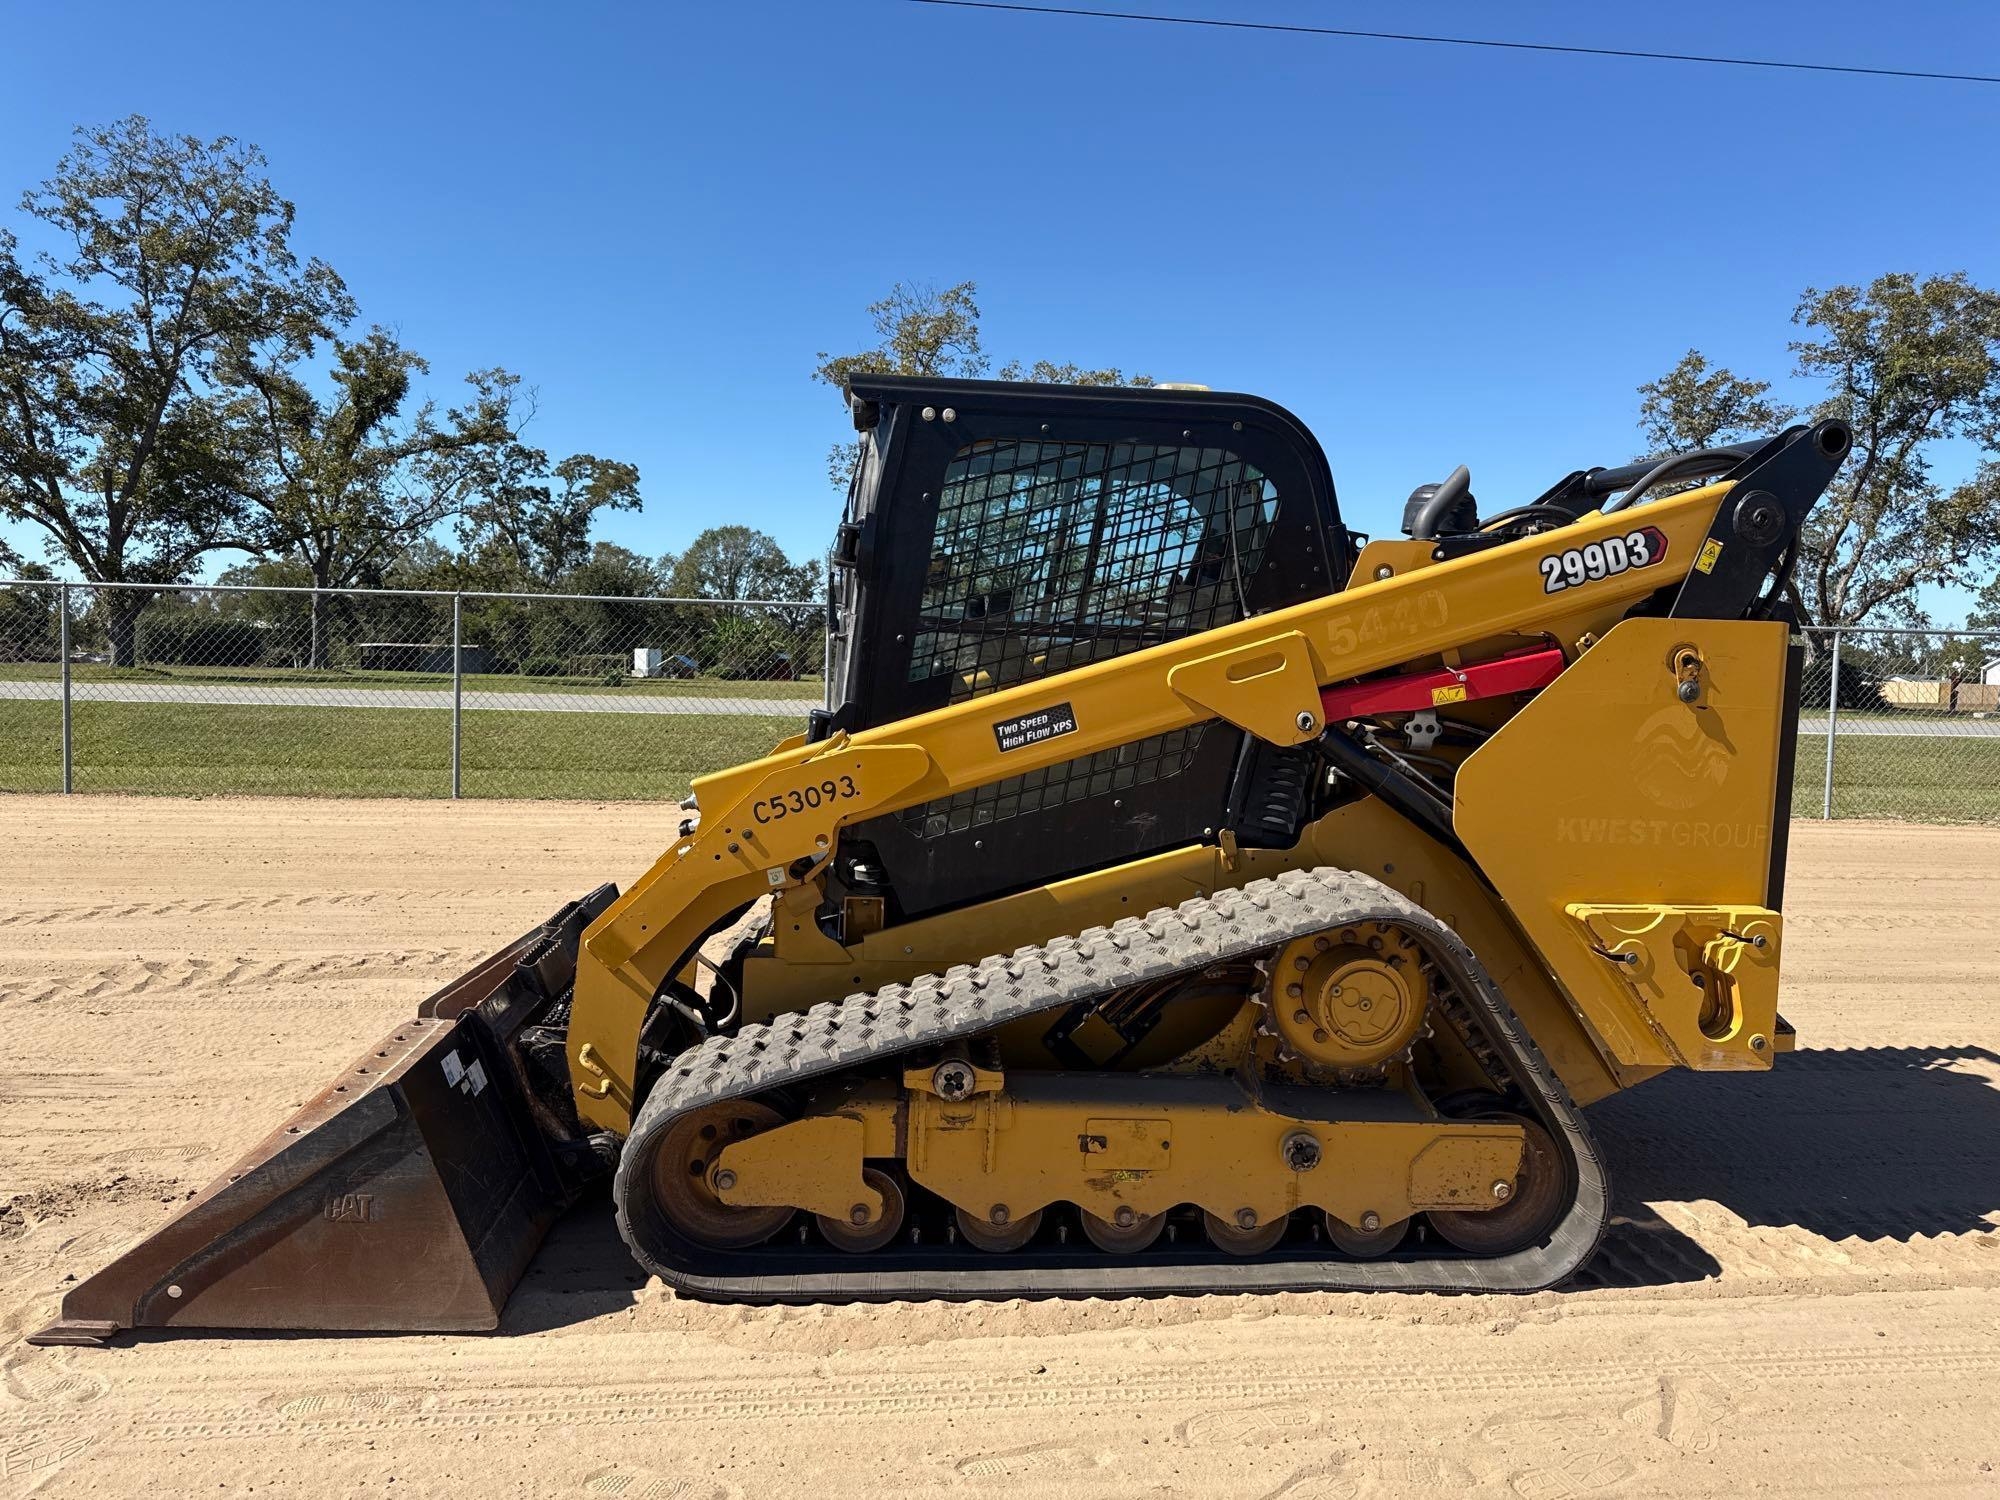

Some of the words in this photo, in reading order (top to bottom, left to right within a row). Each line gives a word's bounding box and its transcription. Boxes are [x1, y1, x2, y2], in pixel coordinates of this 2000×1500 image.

[1541, 532, 1650, 592] 299D3
[1052, 719, 1072, 734] XPS
[323, 1193, 375, 1224] CAT
